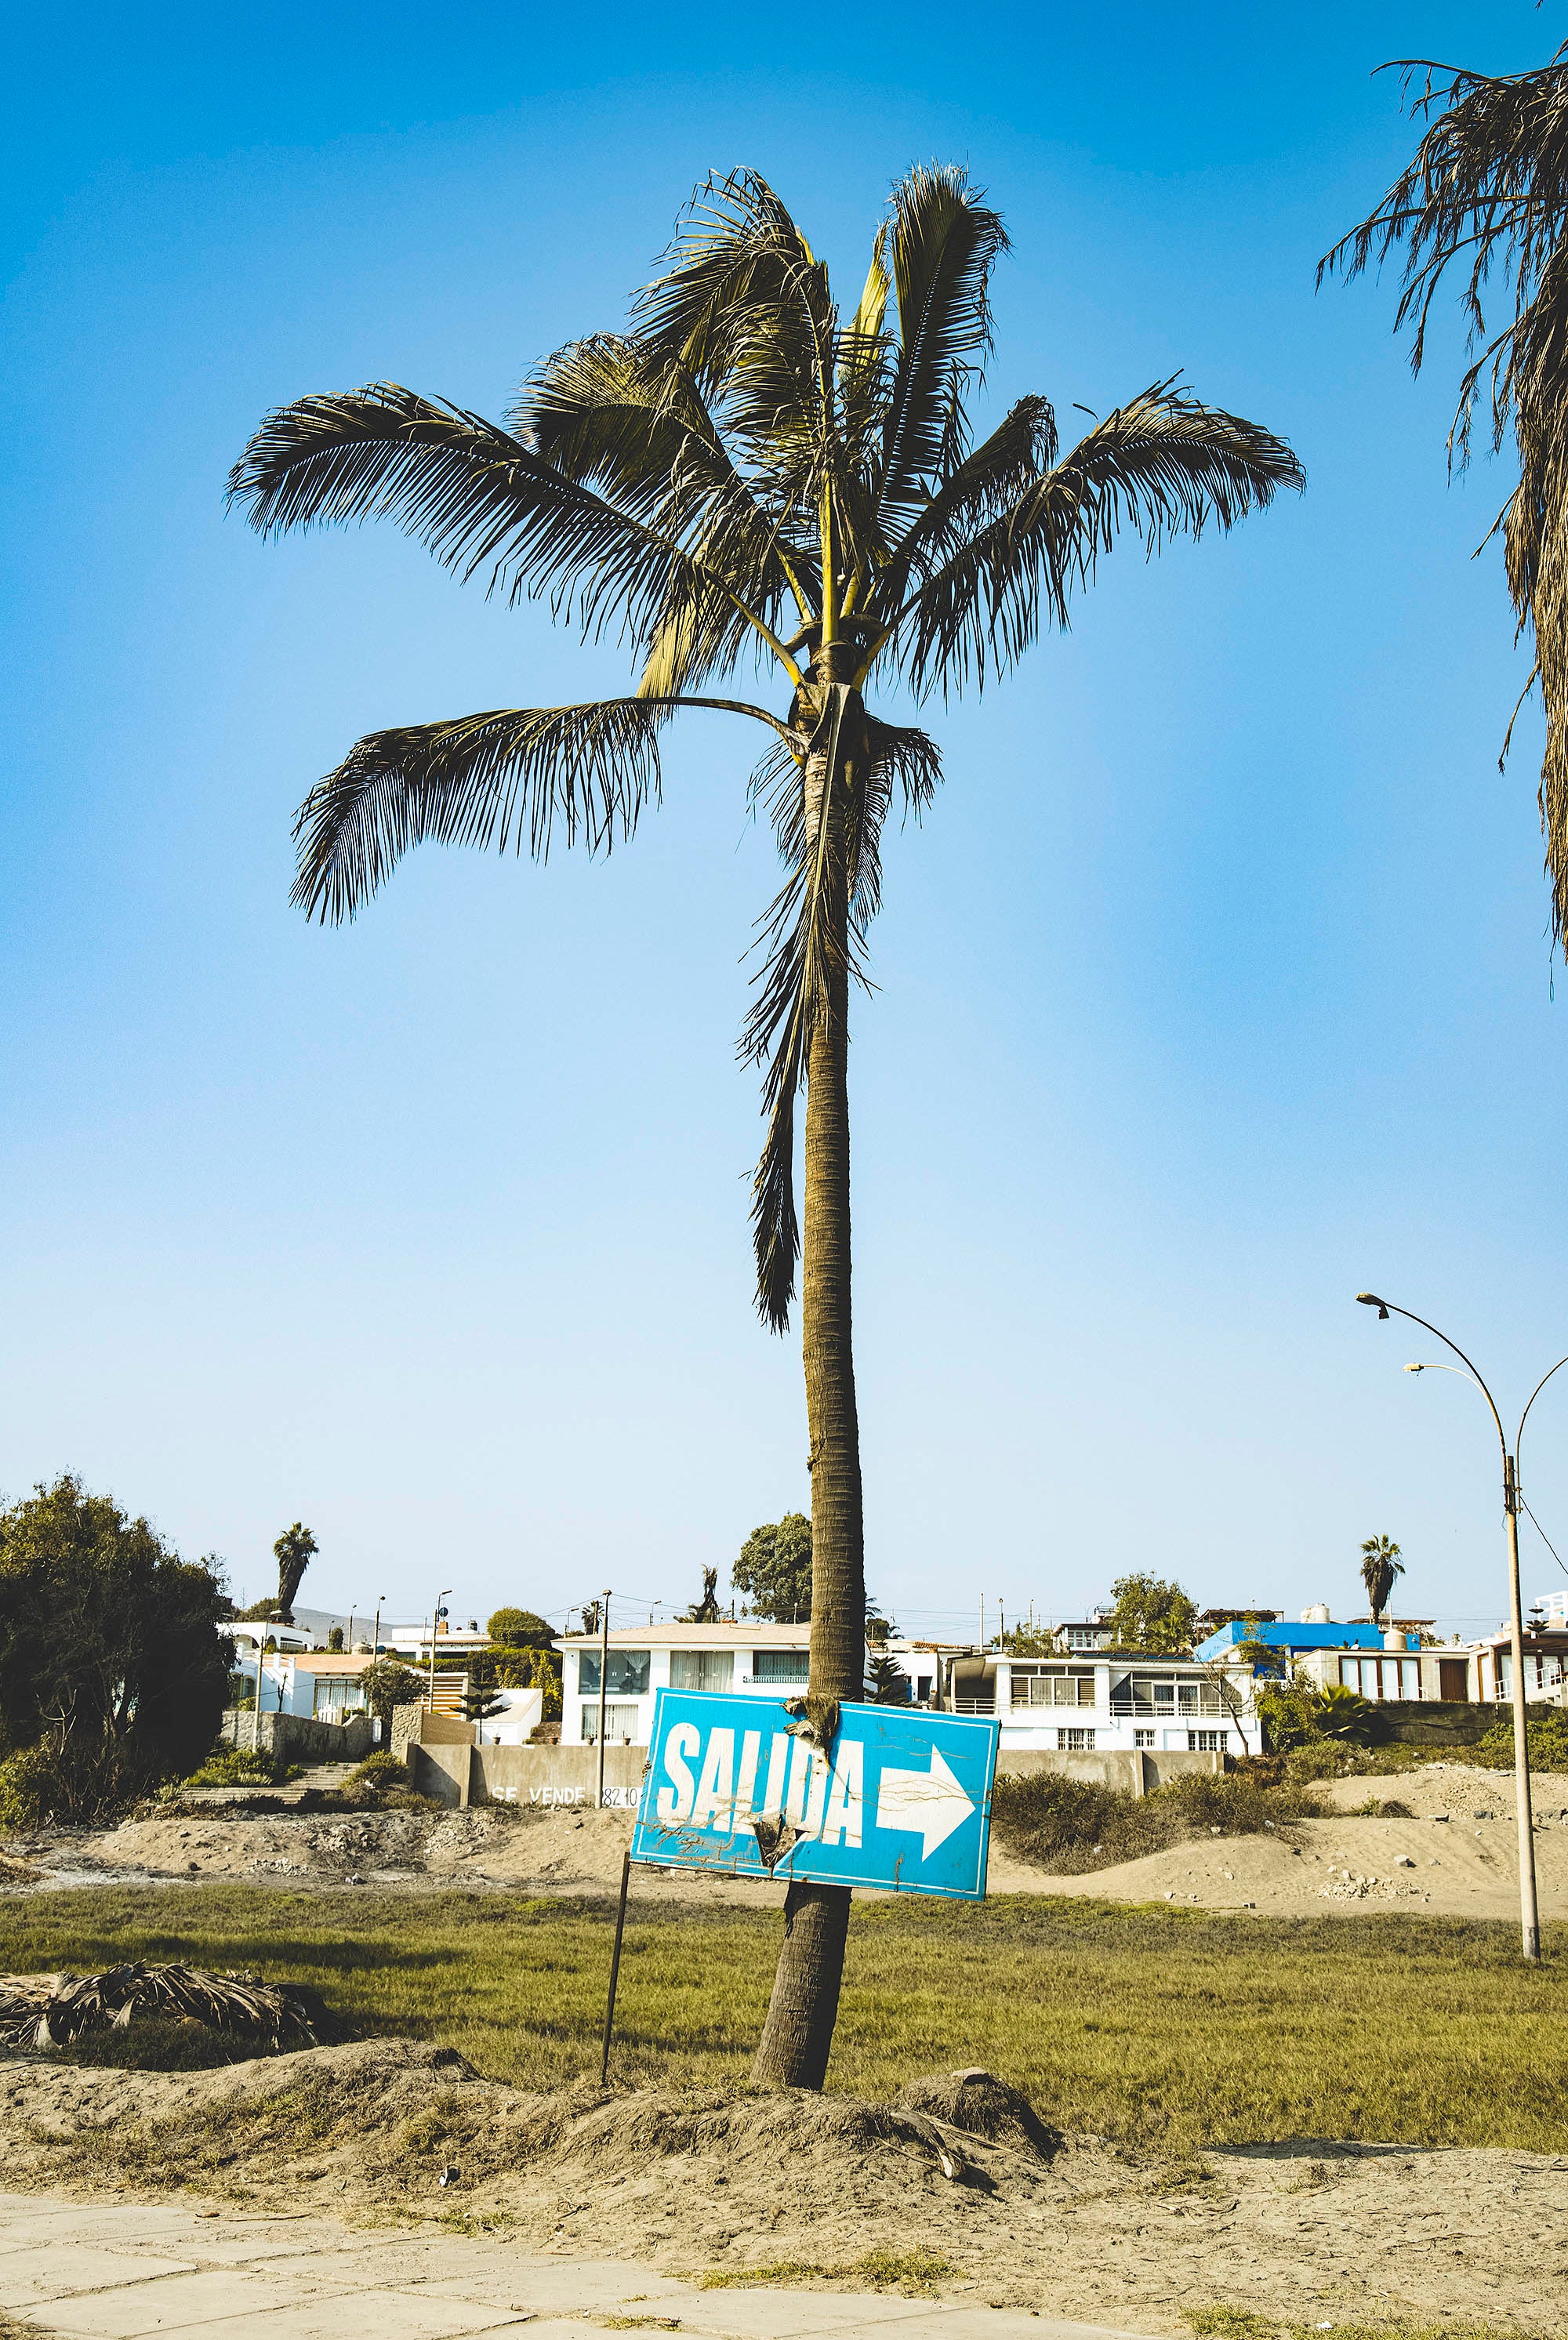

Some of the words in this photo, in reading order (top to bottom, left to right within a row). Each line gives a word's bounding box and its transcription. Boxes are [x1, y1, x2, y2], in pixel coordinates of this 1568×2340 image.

[492, 1787, 518, 1803] SE
[529, 1787, 586, 1805] VENDE
[656, 1722, 865, 1848] SALIDA
